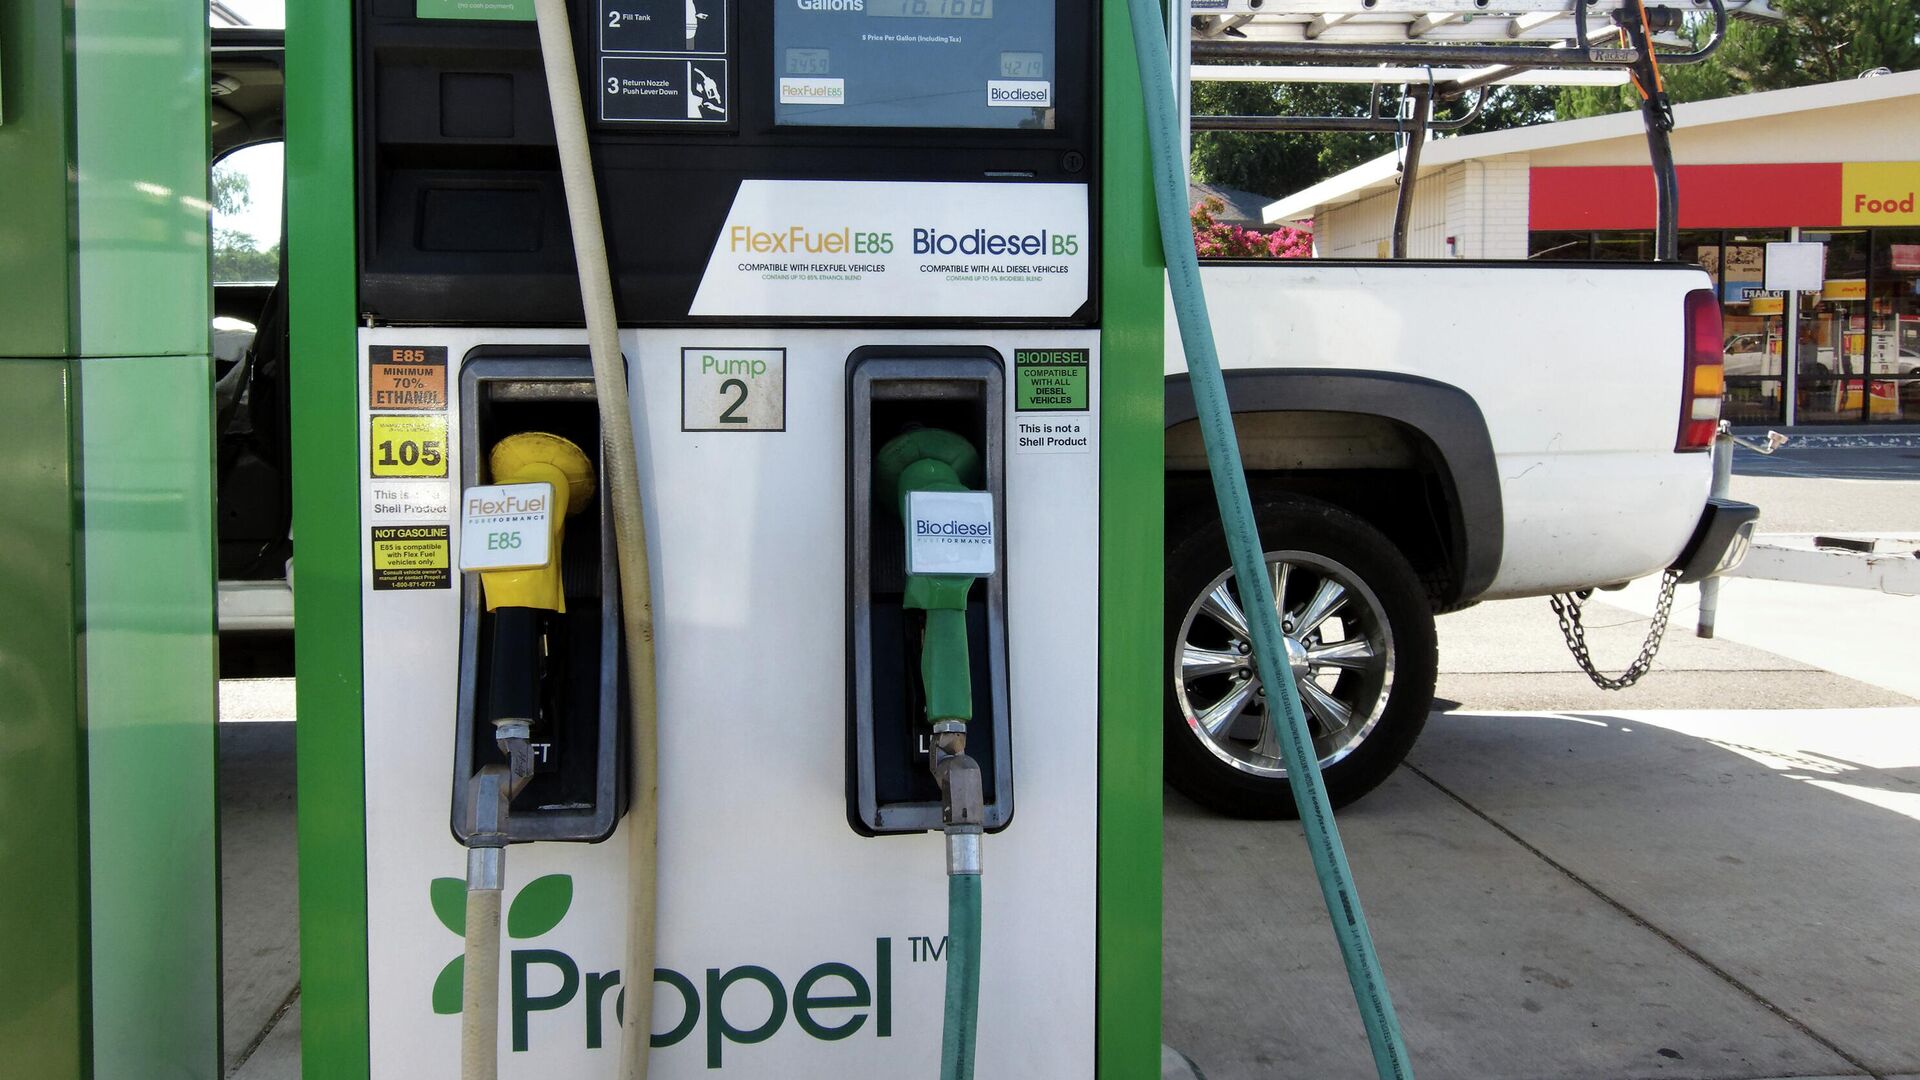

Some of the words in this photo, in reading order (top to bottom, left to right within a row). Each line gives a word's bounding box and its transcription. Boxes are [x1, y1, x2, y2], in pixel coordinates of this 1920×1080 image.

[608, 11, 621, 28] 2
[607, 77, 620, 94] 3
[782, 85, 827, 96] FlexFuel
[828, 87, 842, 96] E85
[991, 88, 1047, 100] Biodiesel
[1855, 192, 1914, 213] Food
[731, 226, 849, 254] FlexFuel
[854, 232, 894, 254] E85
[913, 228, 1047, 256] Biodiesel
[1052, 234, 1078, 256] B5
[738, 263, 788, 272] COMPATIBLE
[789, 264, 809, 272] WITH
[810, 264, 847, 272] FLEXFUEL
[848, 264, 886, 273] VEHICLES
[919, 264, 969, 273] COMPATIBLE
[970, 265, 990, 273] WITH
[991, 265, 1005, 273] ALL
[1006, 265, 1031, 274] DIESEL
[1031, 265, 1069, 274] VEHICLES
[392, 349, 425, 362] E85
[1017, 352, 1088, 364] BIODIESEL
[383, 367, 433, 377] MINIMUM
[702, 355, 767, 379] Pump
[393, 377, 424, 389] 70%
[719, 378, 749, 423] 2
[1019, 424, 1041, 433] This
[1043, 424, 1052, 433] is
[1055, 424, 1072, 433] not
[1019, 437, 1044, 447] Shell
[1047, 437, 1087, 446] Product
[378, 440, 441, 466] 105
[374, 490, 397, 500] This
[374, 503, 401, 513] Shell
[404, 504, 447, 513] Product
[468, 494, 546, 515] FlexFuel
[375, 530, 396, 538] NOT
[397, 529, 447, 538] GASOLINE
[916, 520, 992, 535] Biodiesel
[403, 543, 442, 551] compatible
[487, 532, 522, 550] E85
[511, 937, 892, 1069] Propel
[907, 936, 949, 962] TM
